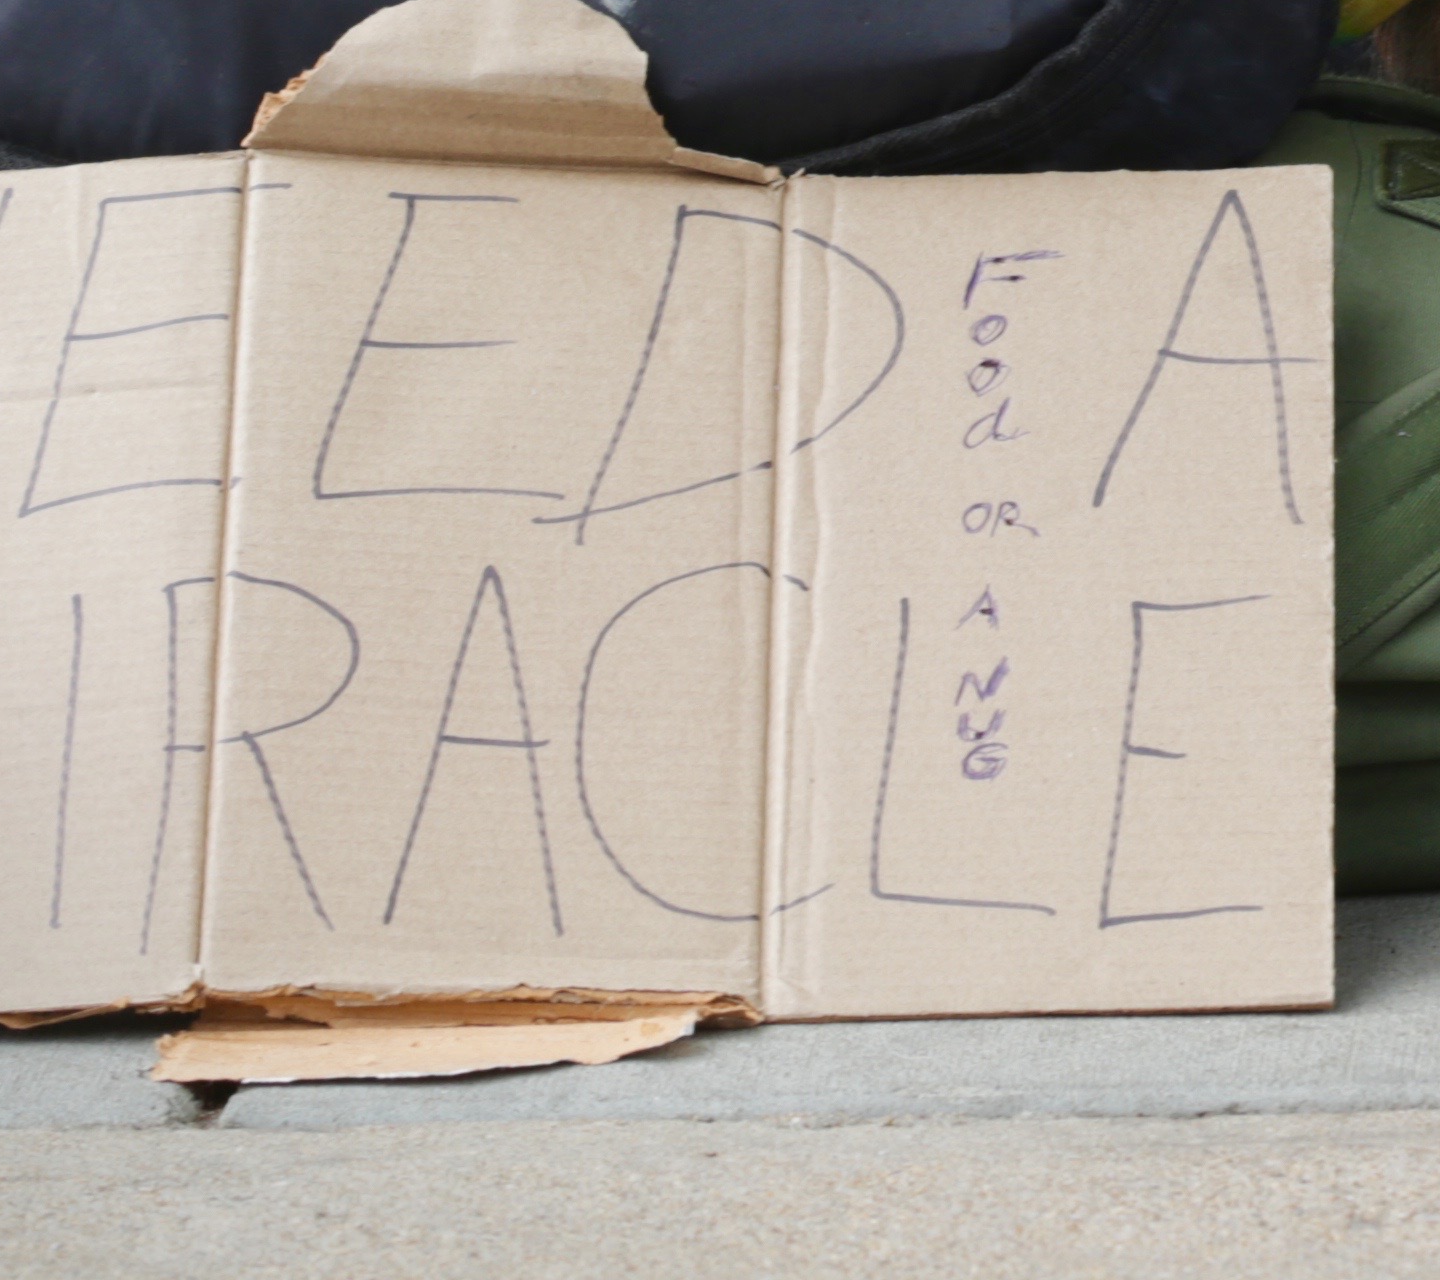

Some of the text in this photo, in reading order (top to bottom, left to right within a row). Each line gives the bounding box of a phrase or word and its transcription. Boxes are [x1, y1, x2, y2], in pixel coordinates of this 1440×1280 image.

[1093, 188, 1324, 526] A
[962, 501, 1041, 538] OR
[954, 583, 1000, 631] A
